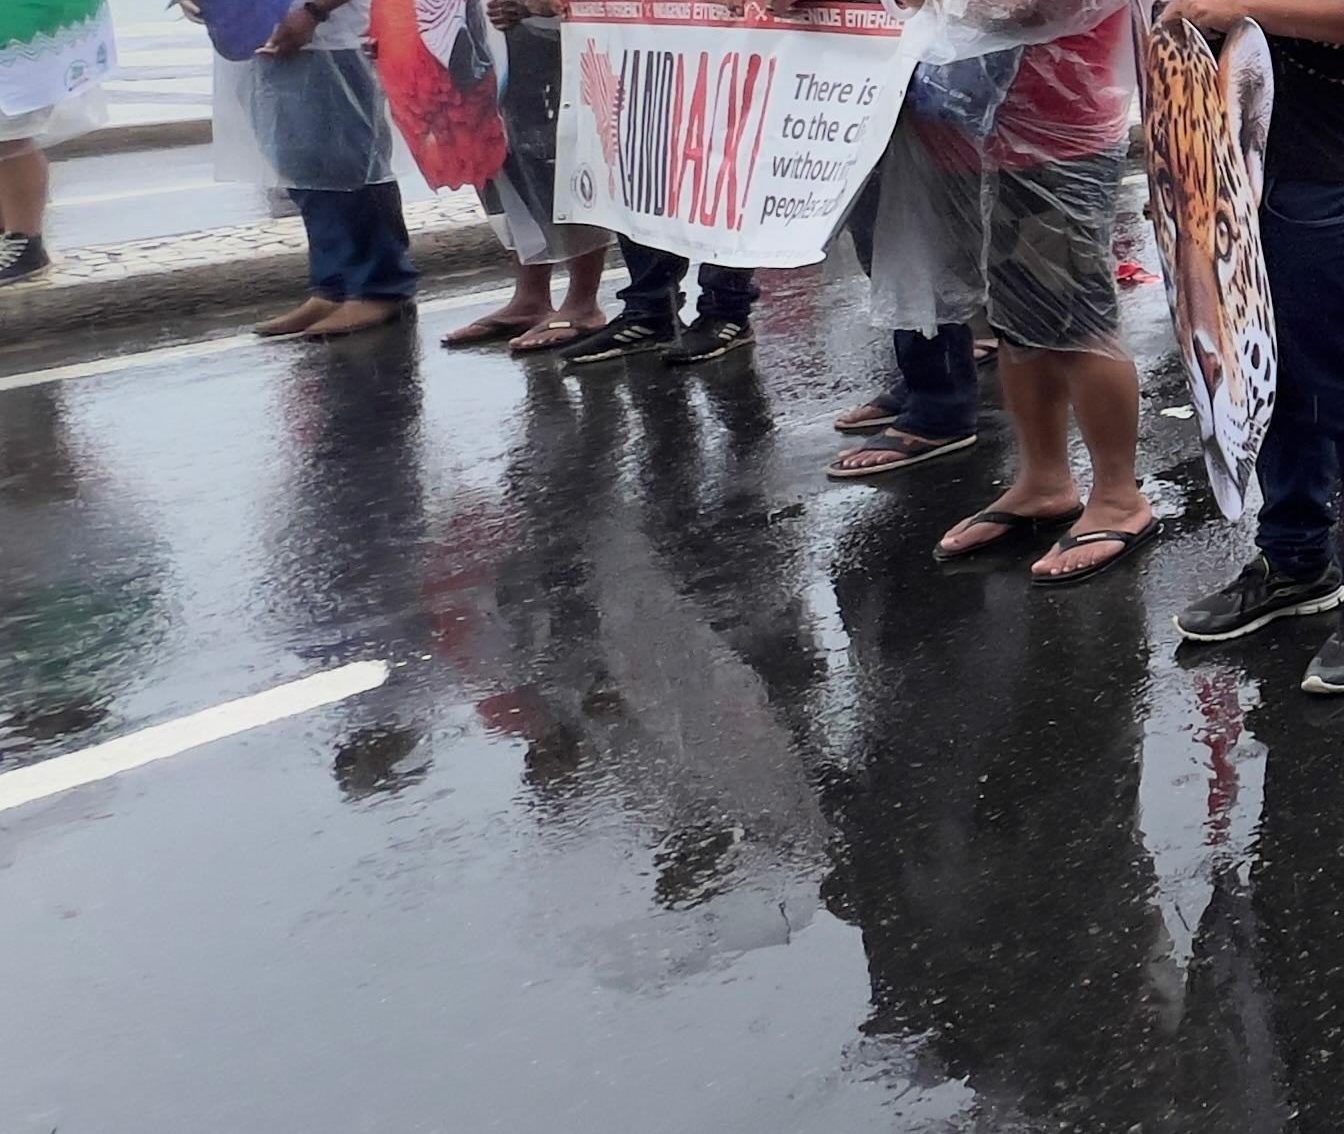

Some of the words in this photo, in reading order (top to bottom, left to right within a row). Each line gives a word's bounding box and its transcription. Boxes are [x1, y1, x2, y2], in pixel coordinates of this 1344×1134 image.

[794, 73, 854, 104] There
[857, 77, 877, 106] is
[782, 113, 806, 140] to
[807, 112, 839, 142] the
